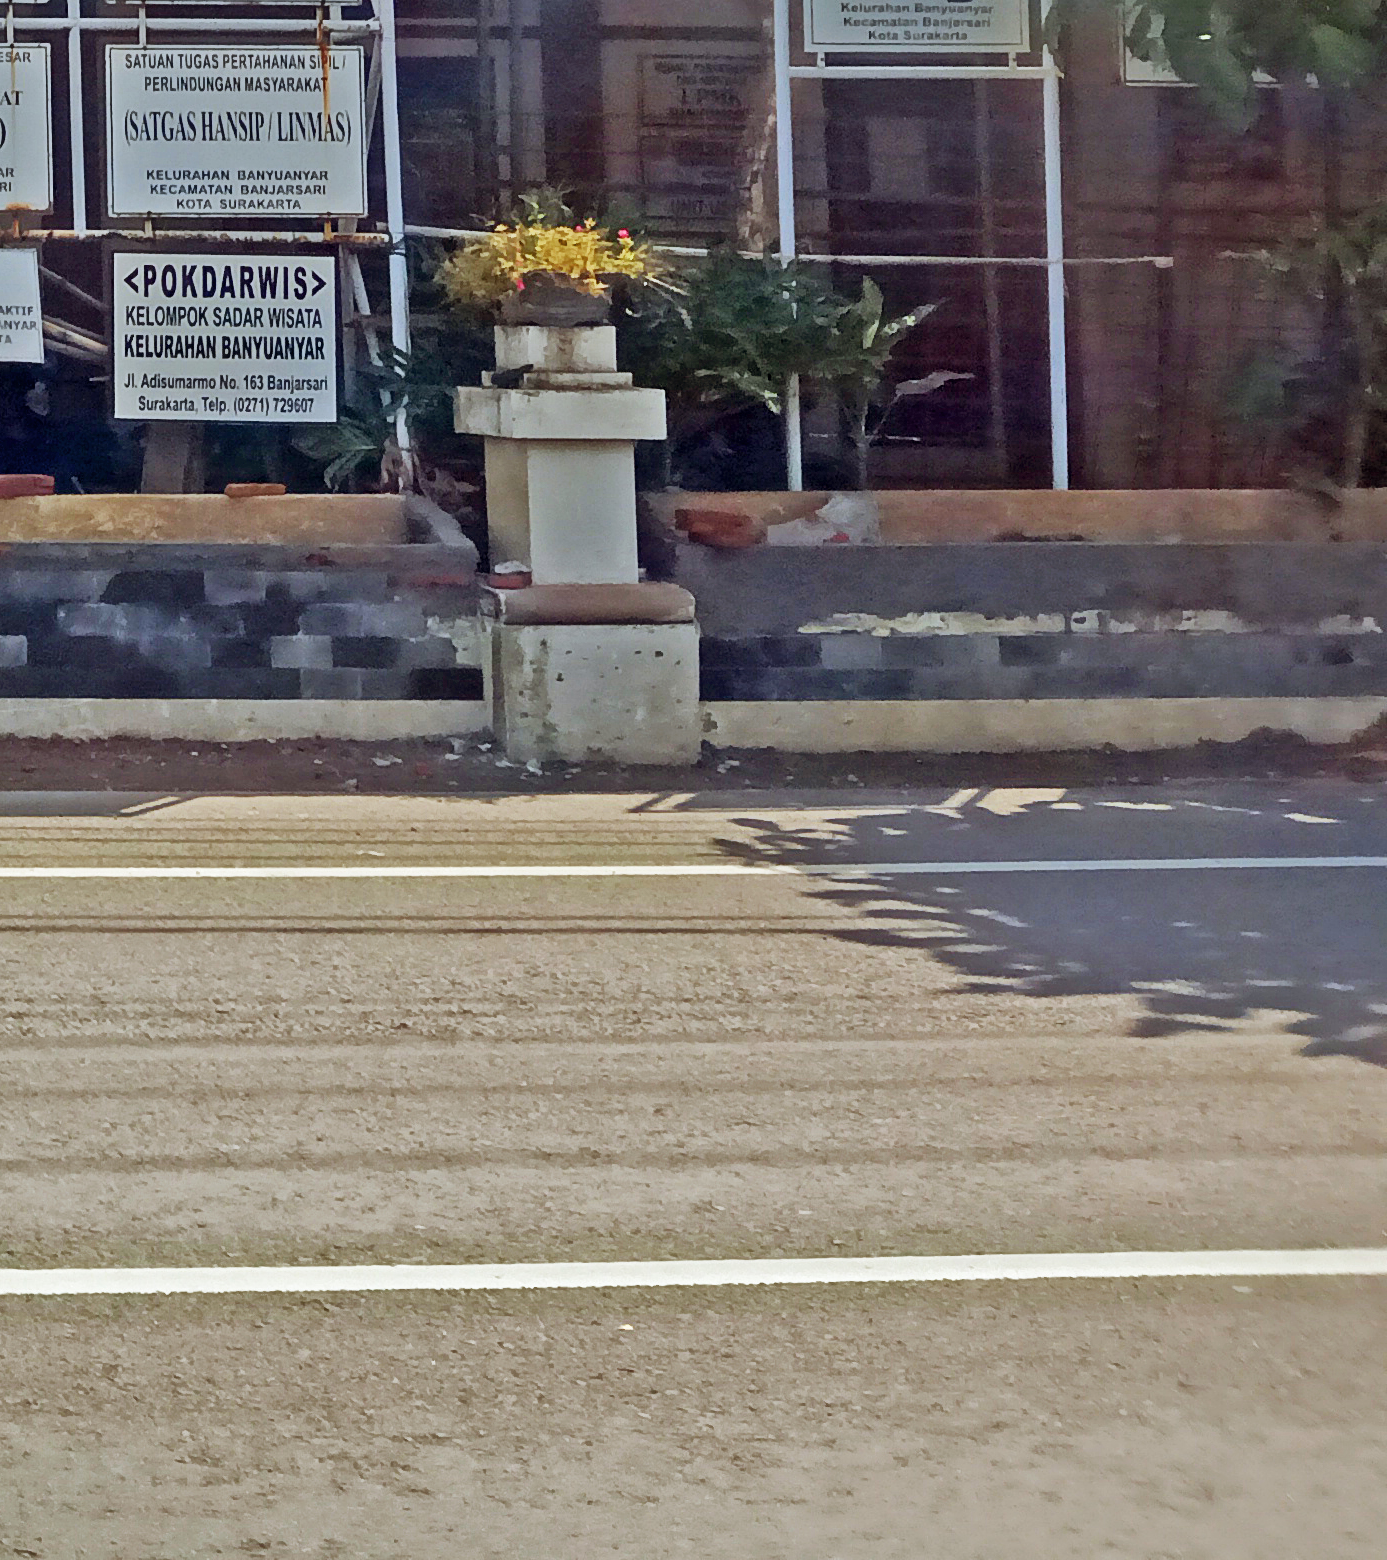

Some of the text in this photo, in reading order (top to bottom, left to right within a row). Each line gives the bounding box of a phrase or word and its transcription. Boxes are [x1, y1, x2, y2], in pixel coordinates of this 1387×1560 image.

[840, 1, 995, 15] Kelurahan Banyuanyar
[843, 16, 991, 30] Kecamatan Banjarsari
[868, 30, 968, 41] Kota Surakarta
[124, 53, 174, 70] SATUAN
[177, 53, 219, 70] TUGAS
[222, 53, 306, 70] PERTAHANAN
[144, 75, 329, 93] PERLINDUNGAN MASYARAKAT
[124, 109, 197, 147] (SATGAS
[200, 110, 265, 142] HANSIP
[276, 107, 352, 146] LINMAS)
[146, 169, 329, 181] KELURAHAN BANYUANYAR
[150, 184, 326, 196] KECAMATAN BANJARSARI
[176, 198, 302, 210] KOTA SURAKARTA
[123, 263, 327, 301] <POKDARWIS>
[125, 305, 323, 329] KELOMPOK SADAR WISATA
[124, 333, 326, 361] KELURAHAN BANYUANYAR
[123, 372, 328, 394] Jl. Adisumarmo No. 163 Banjarsari
[138, 395, 315, 416] Surakarta, Telp. (0271) 729607
